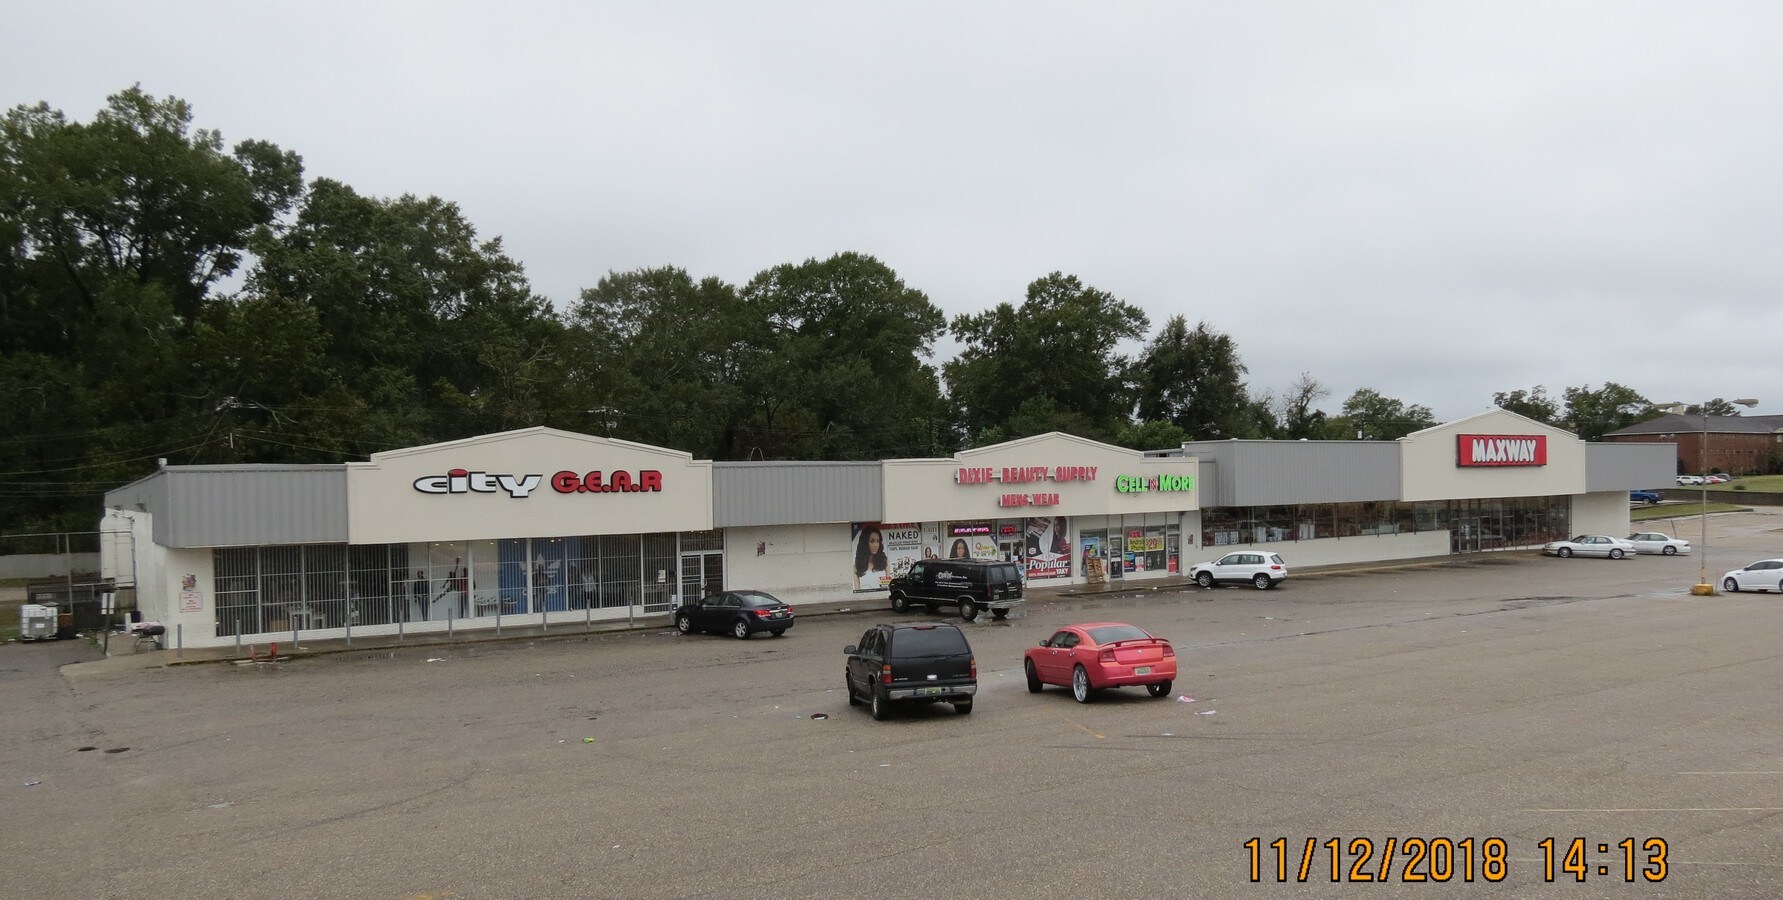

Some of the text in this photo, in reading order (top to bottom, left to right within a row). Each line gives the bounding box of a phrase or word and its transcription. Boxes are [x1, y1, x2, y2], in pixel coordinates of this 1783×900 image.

[1472, 438, 1536, 462] MAXWAY
[413, 468, 662, 498] city G.E.A.R
[958, 466, 1098, 483] DIXIE BEAUTY SUPPLY
[1116, 474, 1147, 493] CELL
[1158, 474, 1195, 491] MORE
[1001, 493, 1060, 507] MENS WEAR
[888, 530, 919, 540] NAKED
[1029, 558, 1068, 572] Popular
